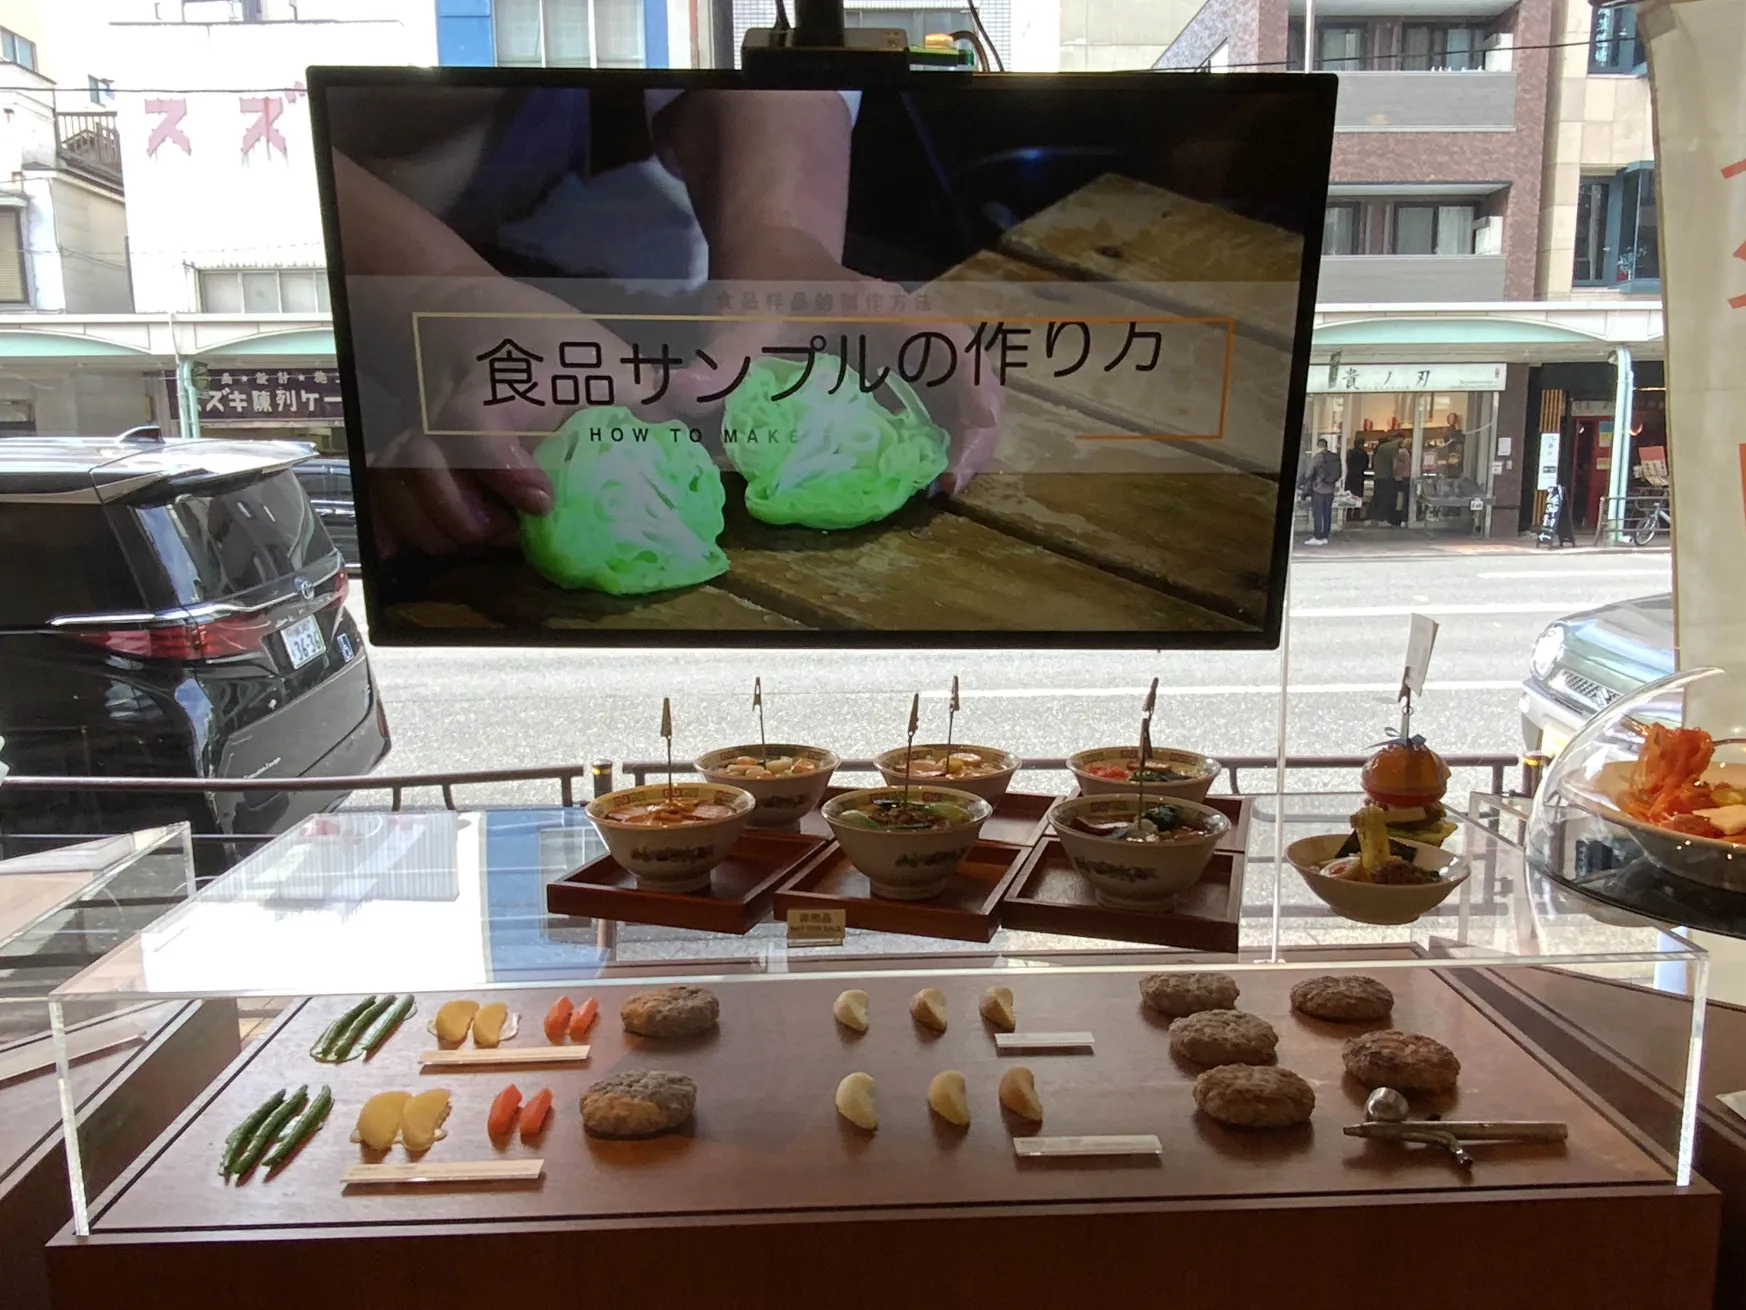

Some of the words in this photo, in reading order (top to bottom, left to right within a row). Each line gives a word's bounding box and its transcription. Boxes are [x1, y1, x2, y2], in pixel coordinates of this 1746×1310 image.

[197, 387, 342, 412] ズキ陳列ケー
[590, 428, 650, 443] HOW
[670, 428, 703, 443] TO
[724, 429, 798, 443] MAKE
